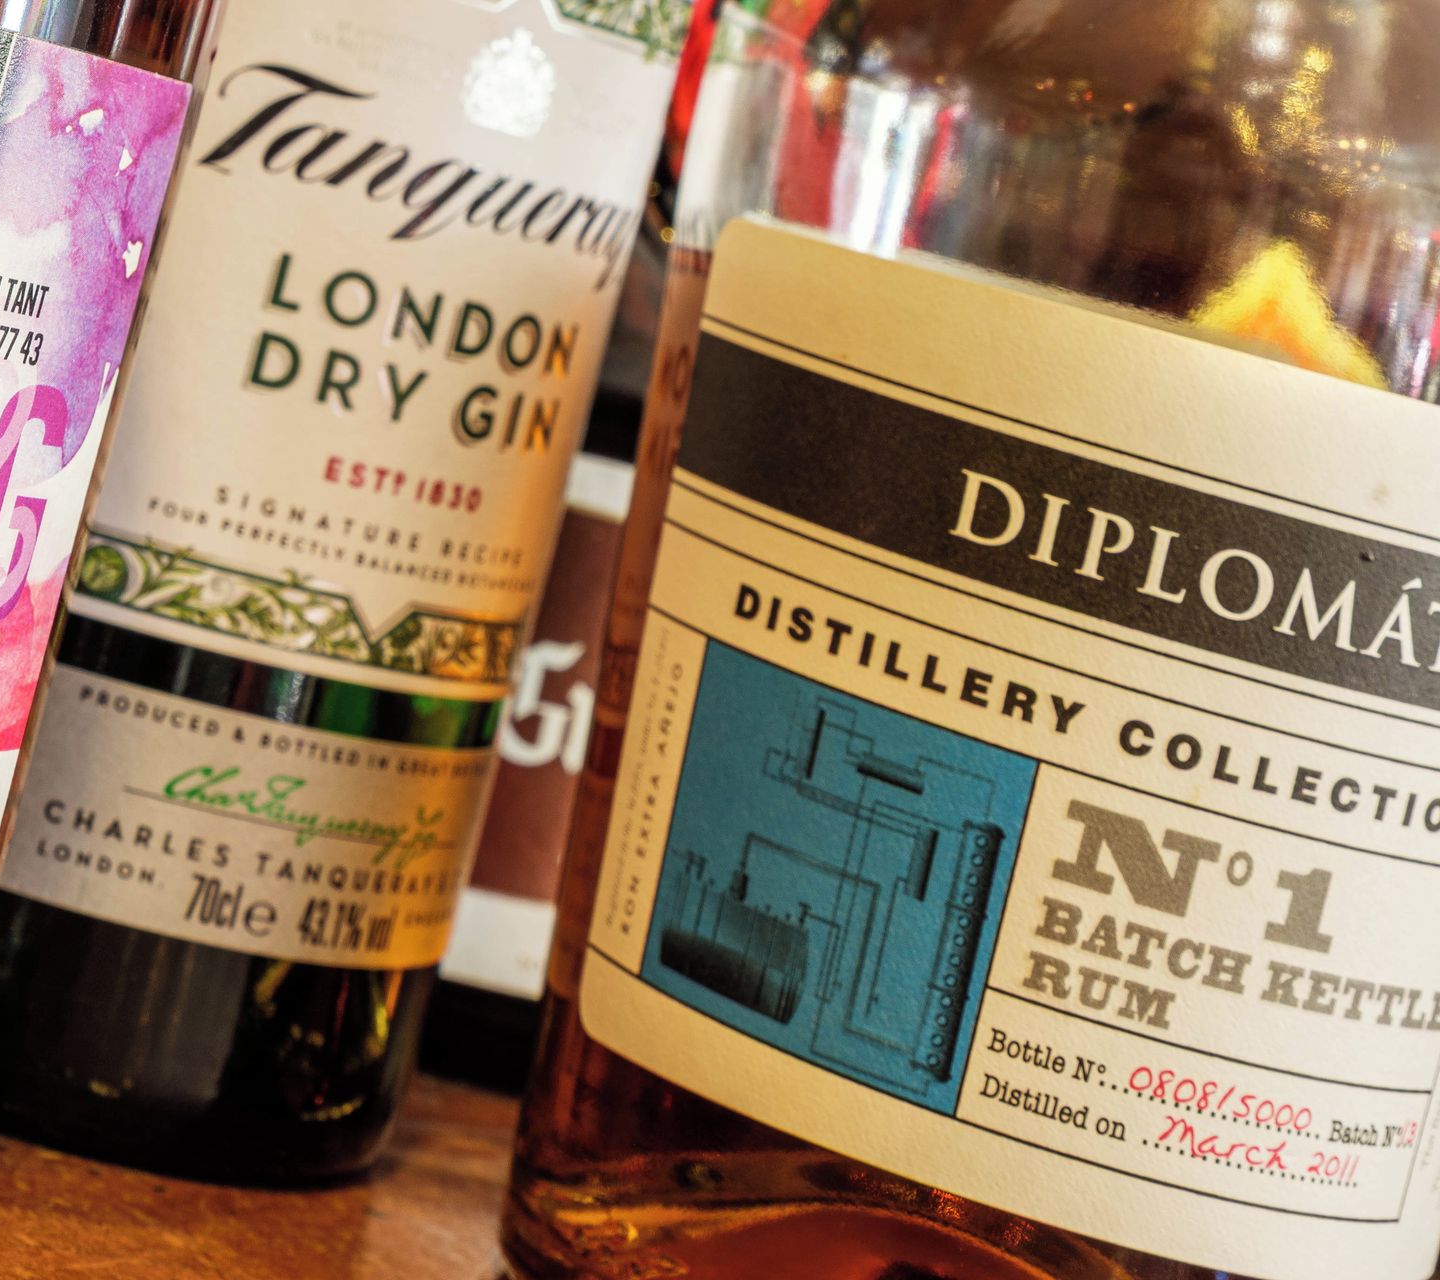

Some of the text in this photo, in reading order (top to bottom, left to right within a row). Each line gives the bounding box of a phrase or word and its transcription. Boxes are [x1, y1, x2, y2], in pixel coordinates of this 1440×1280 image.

[197, 62, 635, 293] Tanqueray
[20, 330, 44, 367] 43
[266, 252, 579, 377] LONDON
[246, 330, 560, 450] DRY GIN
[148, 496, 210, 527] FOUR
[220, 517, 348, 564] PERFECTLY
[214, 485, 421, 553] SIGNATURE
[415, 467, 483, 514] 1830
[734, 583, 1086, 734] DISTILLERY
[79, 684, 221, 737] PRODUCED
[233, 726, 247, 744] &
[259, 731, 361, 766] BOTTLED
[44, 799, 231, 868] CHARLES
[184, 873, 244, 930] 70cl
[1263, 867, 1335, 955] 1
[1022, 951, 1176, 1030] RUM
[1035, 896, 1440, 1031] BATCH KETTLE
[979, 1073, 1359, 1182] Distilled on March 2011
[987, 1027, 1066, 1075] Bottle
[1327, 1120, 1380, 1148] Batch
